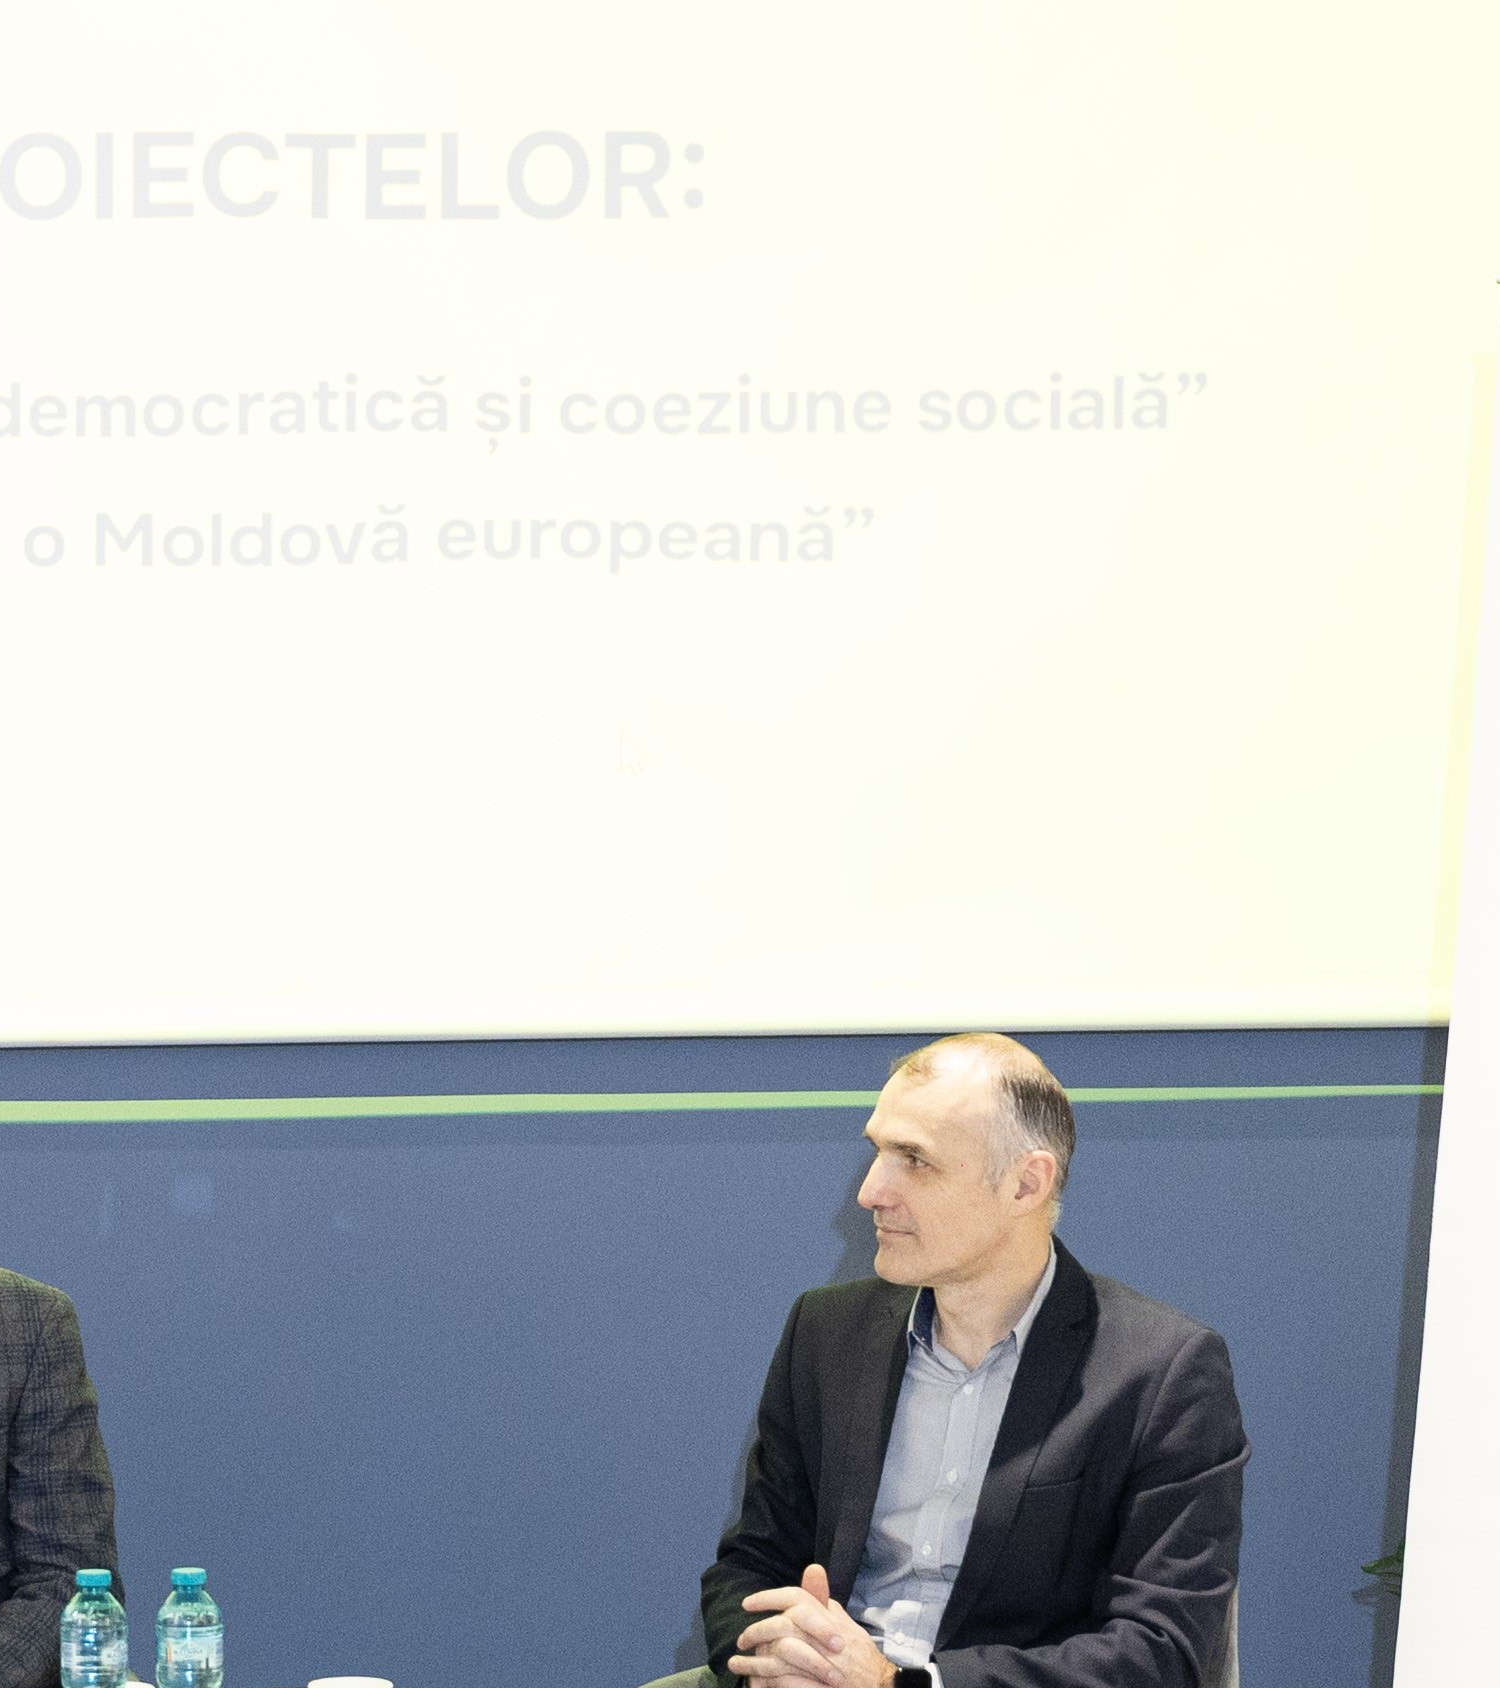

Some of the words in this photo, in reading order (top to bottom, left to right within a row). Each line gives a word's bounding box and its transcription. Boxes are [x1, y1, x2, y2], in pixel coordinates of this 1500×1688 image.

[477, 375, 534, 453] și
[558, 375, 892, 435] coeziune
[23, 522, 65, 568] o
[93, 504, 410, 568] Moldovă
